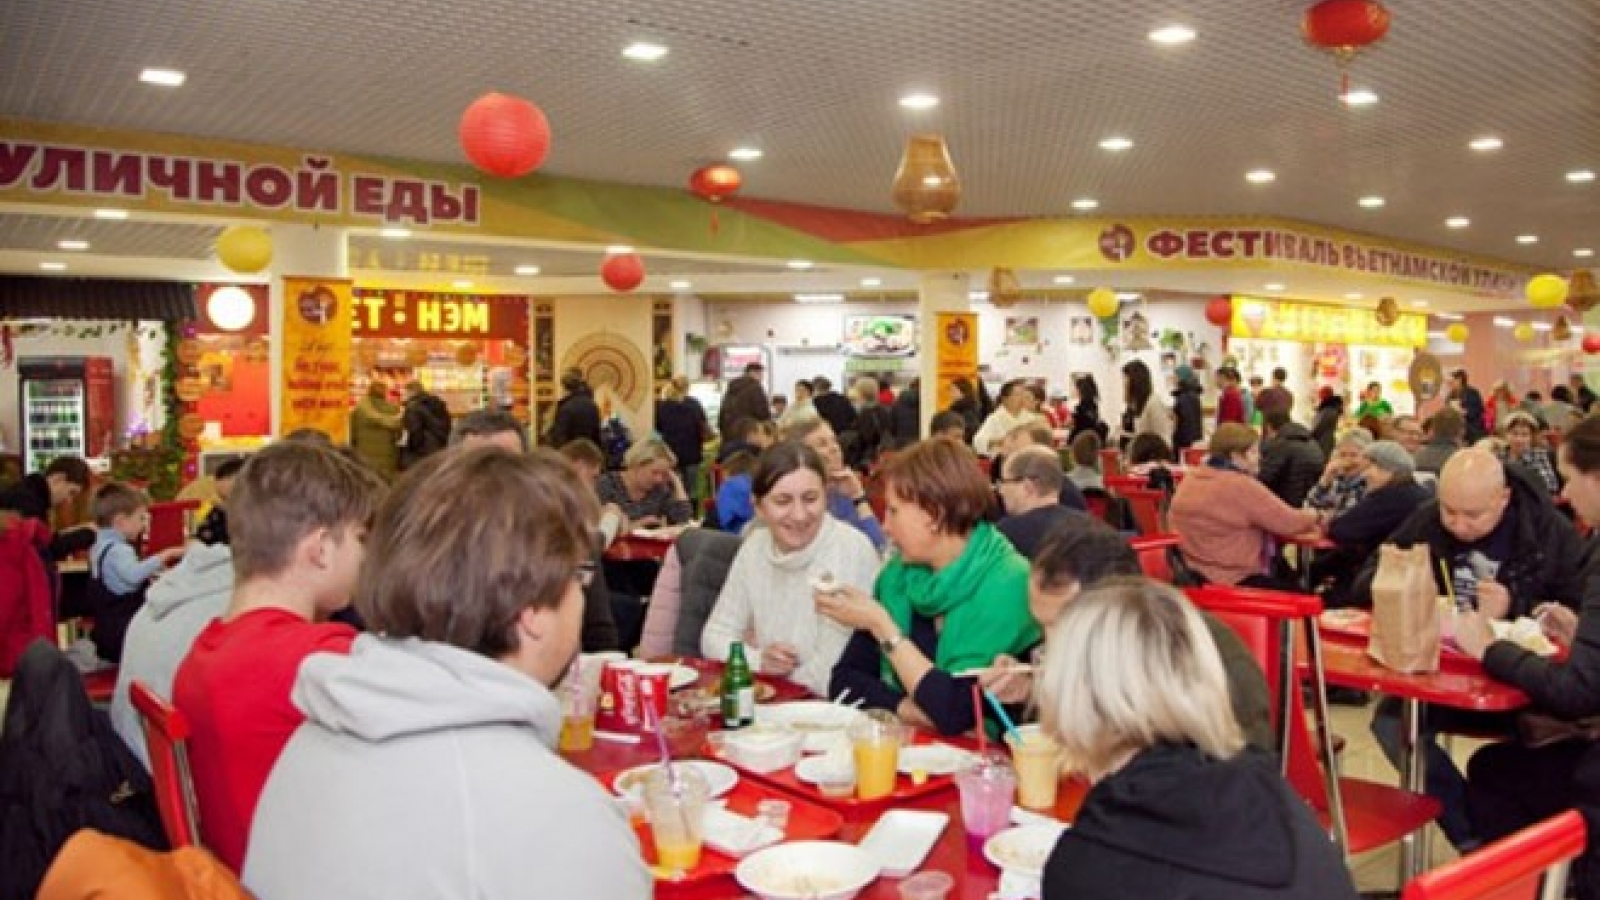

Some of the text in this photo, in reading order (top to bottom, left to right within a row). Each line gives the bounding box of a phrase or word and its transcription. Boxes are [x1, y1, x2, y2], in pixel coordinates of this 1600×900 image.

[0, 142, 479, 225] УЛИЧНОЙ ЕДЫ
[1148, 230, 1339, 267] ФЕСТИВАЛЬ
[1342, 244, 1471, 286] ВЬЕТНАМСКОЙ
[418, 300, 490, 334] НЭМ
